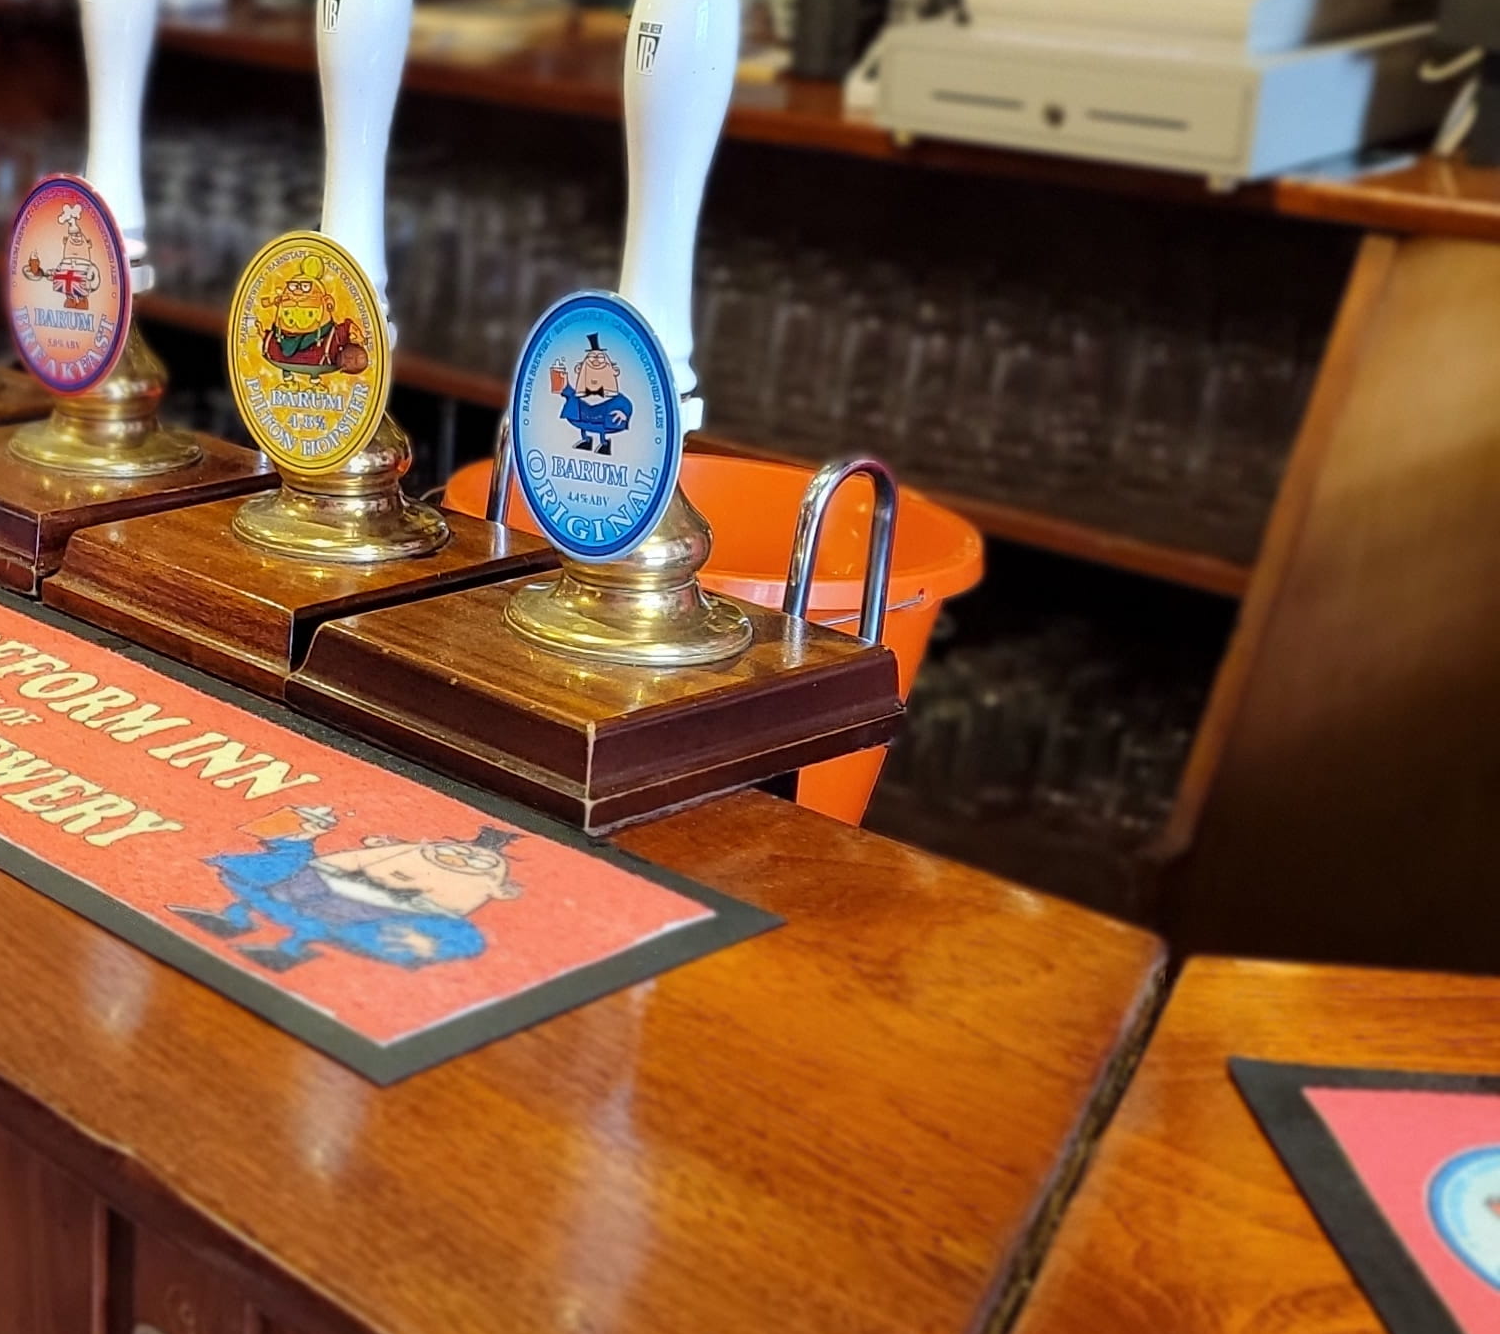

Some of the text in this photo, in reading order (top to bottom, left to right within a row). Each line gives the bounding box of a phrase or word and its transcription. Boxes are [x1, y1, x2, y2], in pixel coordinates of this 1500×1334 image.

[34, 307, 95, 333] BARUM
[12, 305, 115, 380] BREAKFAST
[245, 377, 370, 457] PILTON HOPSTER
[271, 389, 344, 412] BARUM
[654, 403, 664, 429] ALES
[551, 455, 628, 488] BARUM
[526, 448, 660, 542] ORIGINAL
[590, 495, 610, 508] ABV
[147, 731, 322, 800] INN
